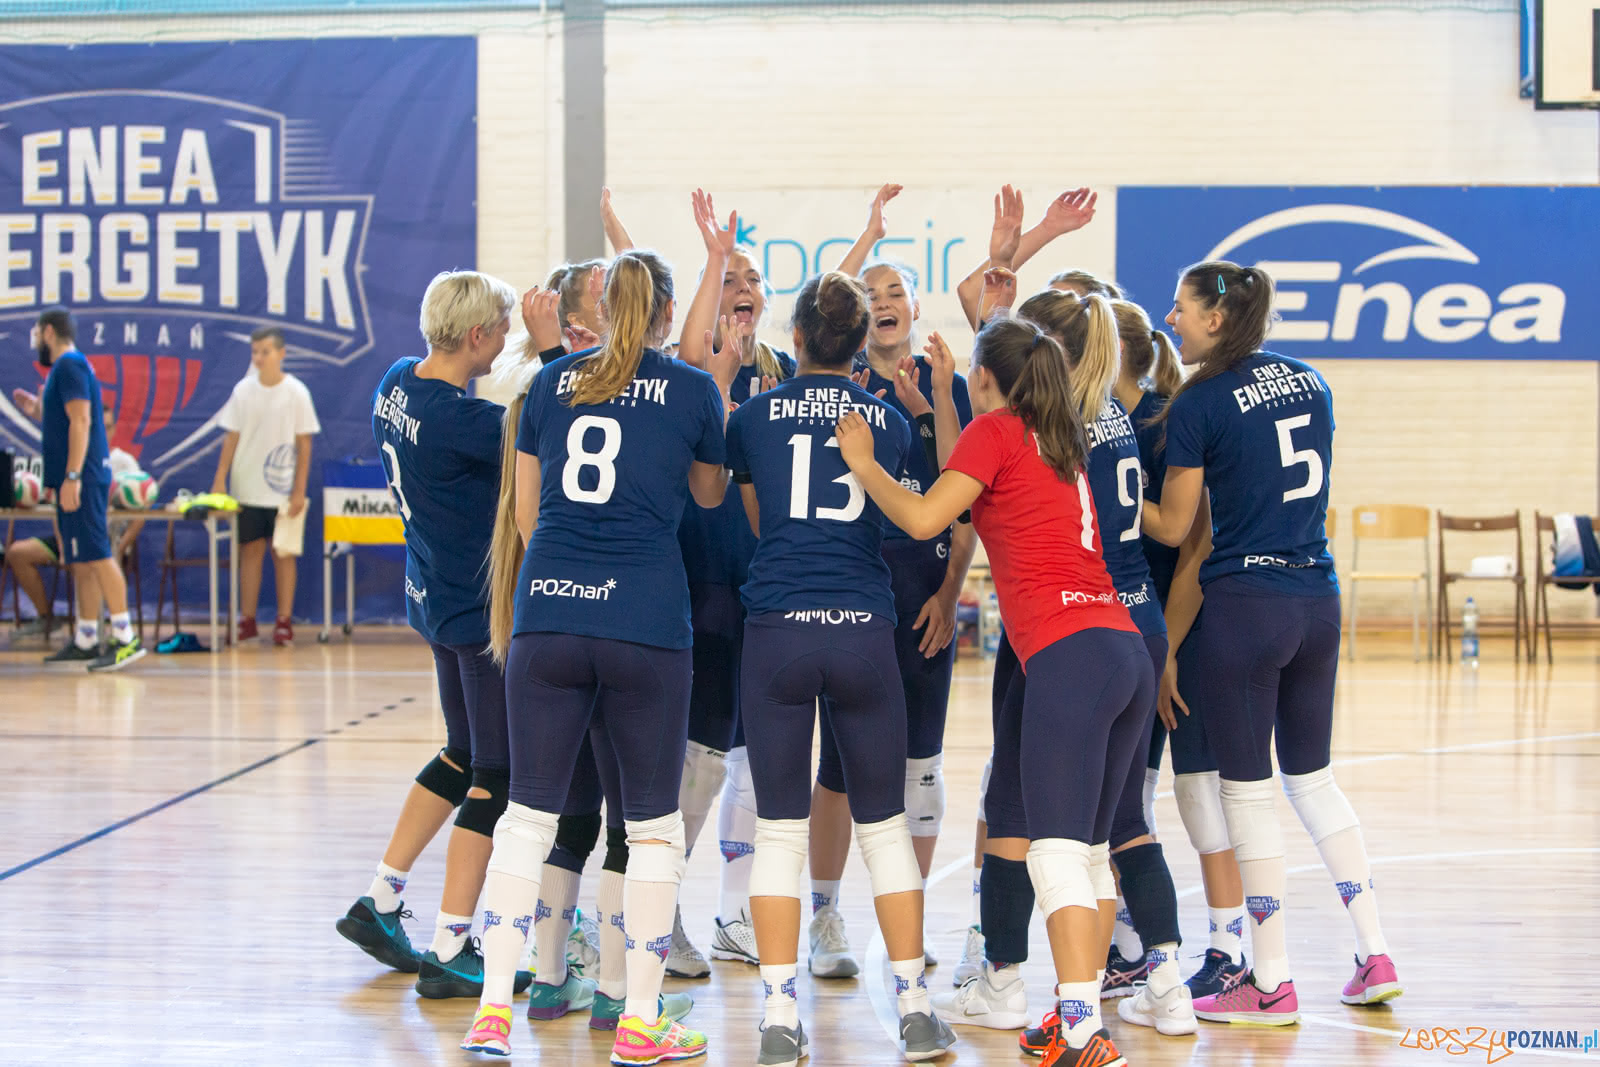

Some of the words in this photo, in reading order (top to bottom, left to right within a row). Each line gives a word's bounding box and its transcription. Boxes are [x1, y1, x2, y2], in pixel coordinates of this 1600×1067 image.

[22, 125, 218, 205] ENEA
[1254, 260, 1567, 342] Enea
[30, 322, 204, 350] ZNAŃ
[1232, 371, 1326, 413] ENERGETYK
[1251, 362, 1293, 381] ENEA
[769, 398, 887, 431] ENERGETYK
[805, 388, 852, 402] ENEA
[798, 418, 836, 426] POZN
[561, 414, 622, 504] 8
[786, 433, 866, 522] 13
[1274, 413, 1324, 504] 5
[899, 477, 922, 492] ea
[1116, 456, 1144, 542] 9
